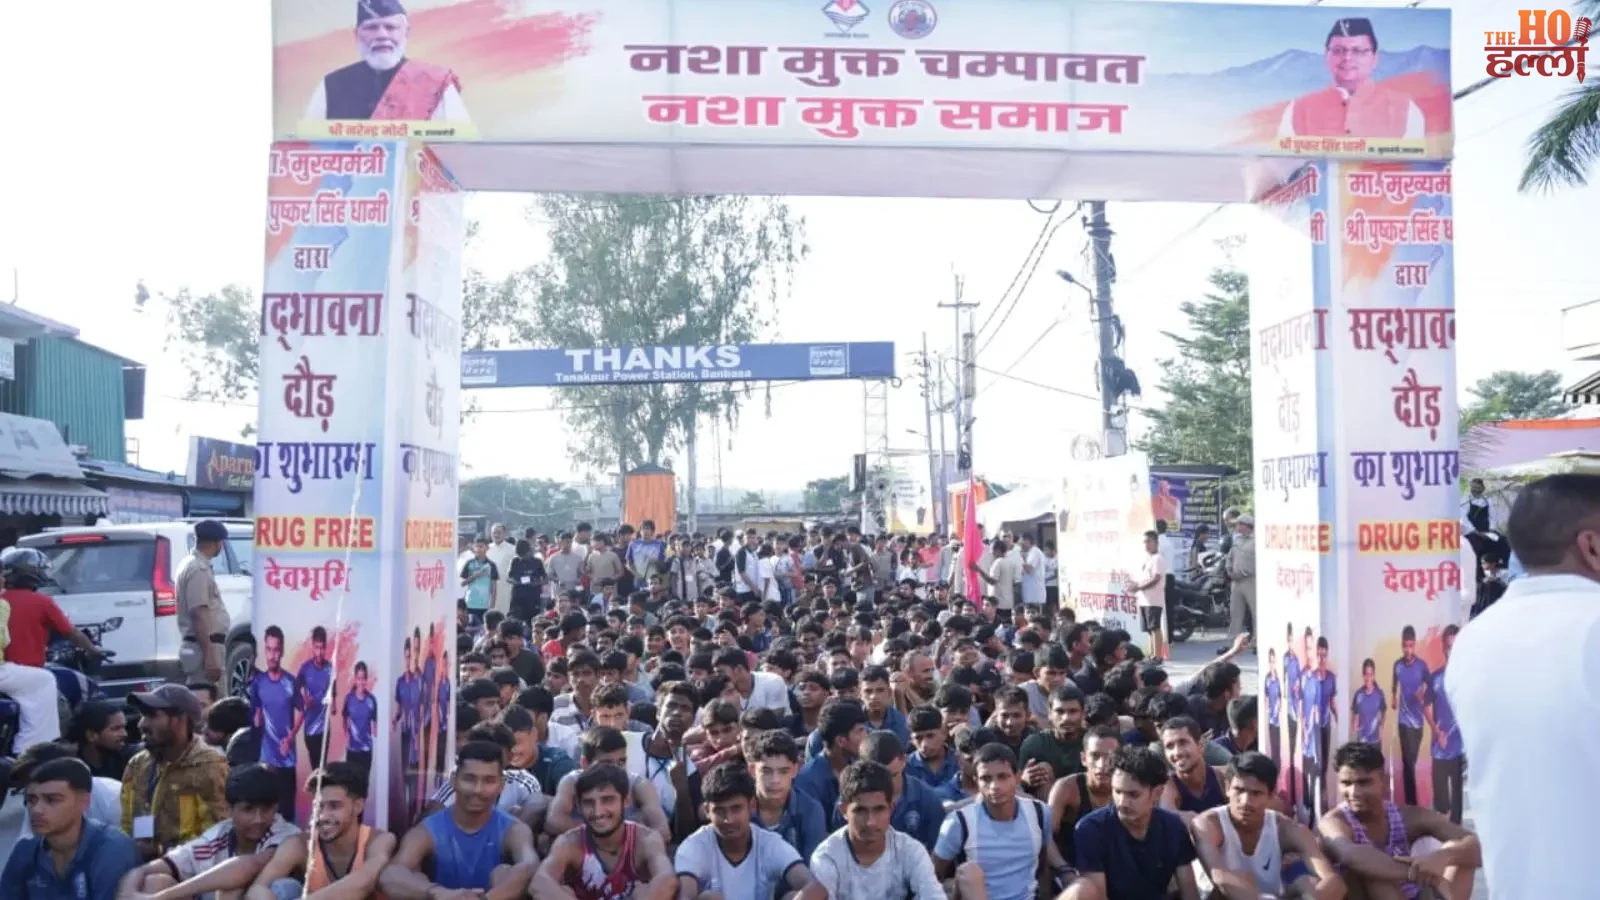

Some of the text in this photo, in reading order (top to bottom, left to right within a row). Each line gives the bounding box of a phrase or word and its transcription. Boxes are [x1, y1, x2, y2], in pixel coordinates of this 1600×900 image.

[624, 45, 1146, 87] नशा मुक्त चम्पावत
[642, 95, 1128, 139] नशा मुक्त समाज
[291, 147, 385, 181] मुख्यमंत्री
[269, 199, 312, 231] पुष्कर
[315, 193, 347, 223] सिंह
[351, 193, 389, 223] धामी
[1347, 212, 1366, 242] श्री
[1368, 219, 1408, 250] पुष्कर
[1411, 212, 1440, 241] सिंह
[294, 247, 330, 269] द्वारा
[1394, 265, 1428, 285] द्वारा
[555, 371, 610, 383] Tanakpur
[613, 370, 651, 381] Power
[565, 345, 741, 372] THANKS
[282, 355, 337, 433] दौड़
[1391, 368, 1442, 441] दौड़
[1351, 451, 1387, 487] का
[313, 518, 373, 548] FREE
[1359, 524, 1420, 551] DRUG
[264, 557, 352, 600] देवभूमि
